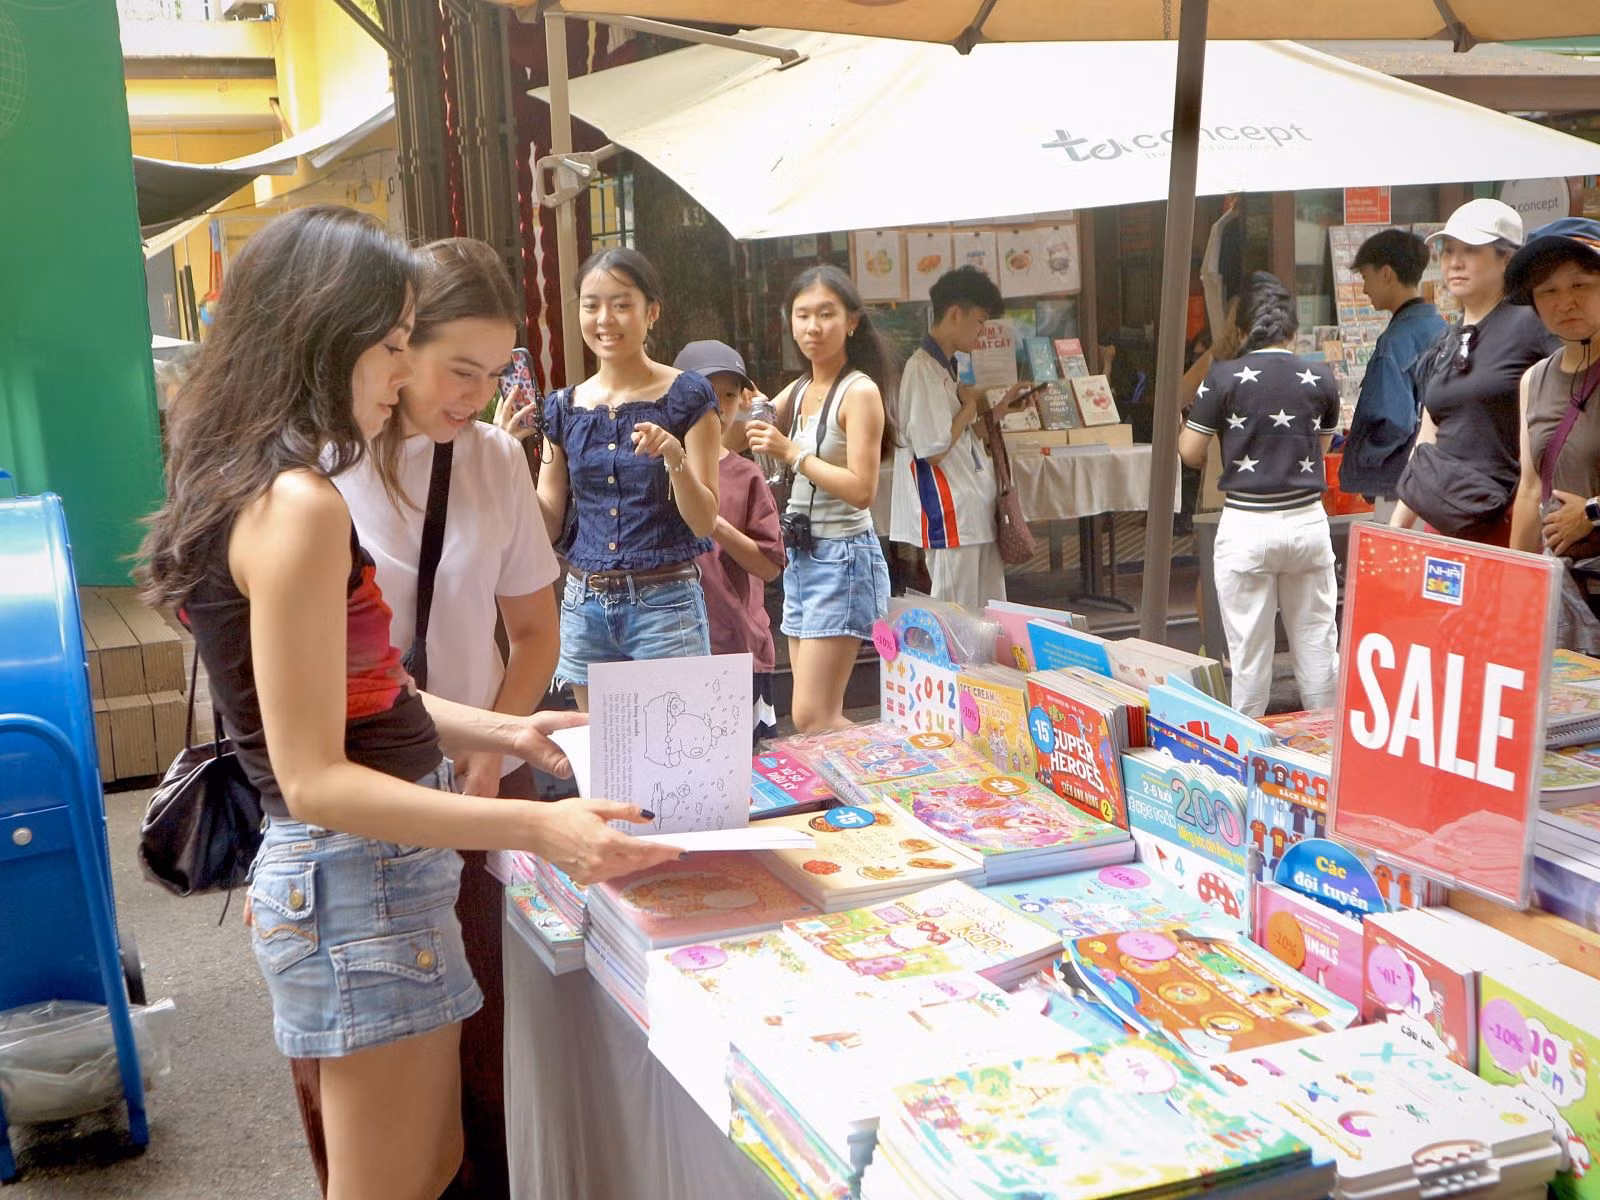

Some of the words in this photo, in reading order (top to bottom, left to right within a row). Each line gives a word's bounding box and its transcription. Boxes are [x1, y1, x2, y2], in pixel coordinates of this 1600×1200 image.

[1518, 198, 1559, 215] concept
[876, 636, 893, 651] -10%
[1350, 632, 1525, 792] SALE
[1054, 727, 1097, 767] SUPER
[1050, 751, 1105, 793] HEROES
[1171, 777, 1242, 847] 200
[1315, 855, 1347, 879] Các
[1293, 871, 1319, 893] đội
[1322, 883, 1369, 912] tuyển
[1488, 1023, 1524, 1054] -10%
[1530, 1029, 1558, 1066] 10
